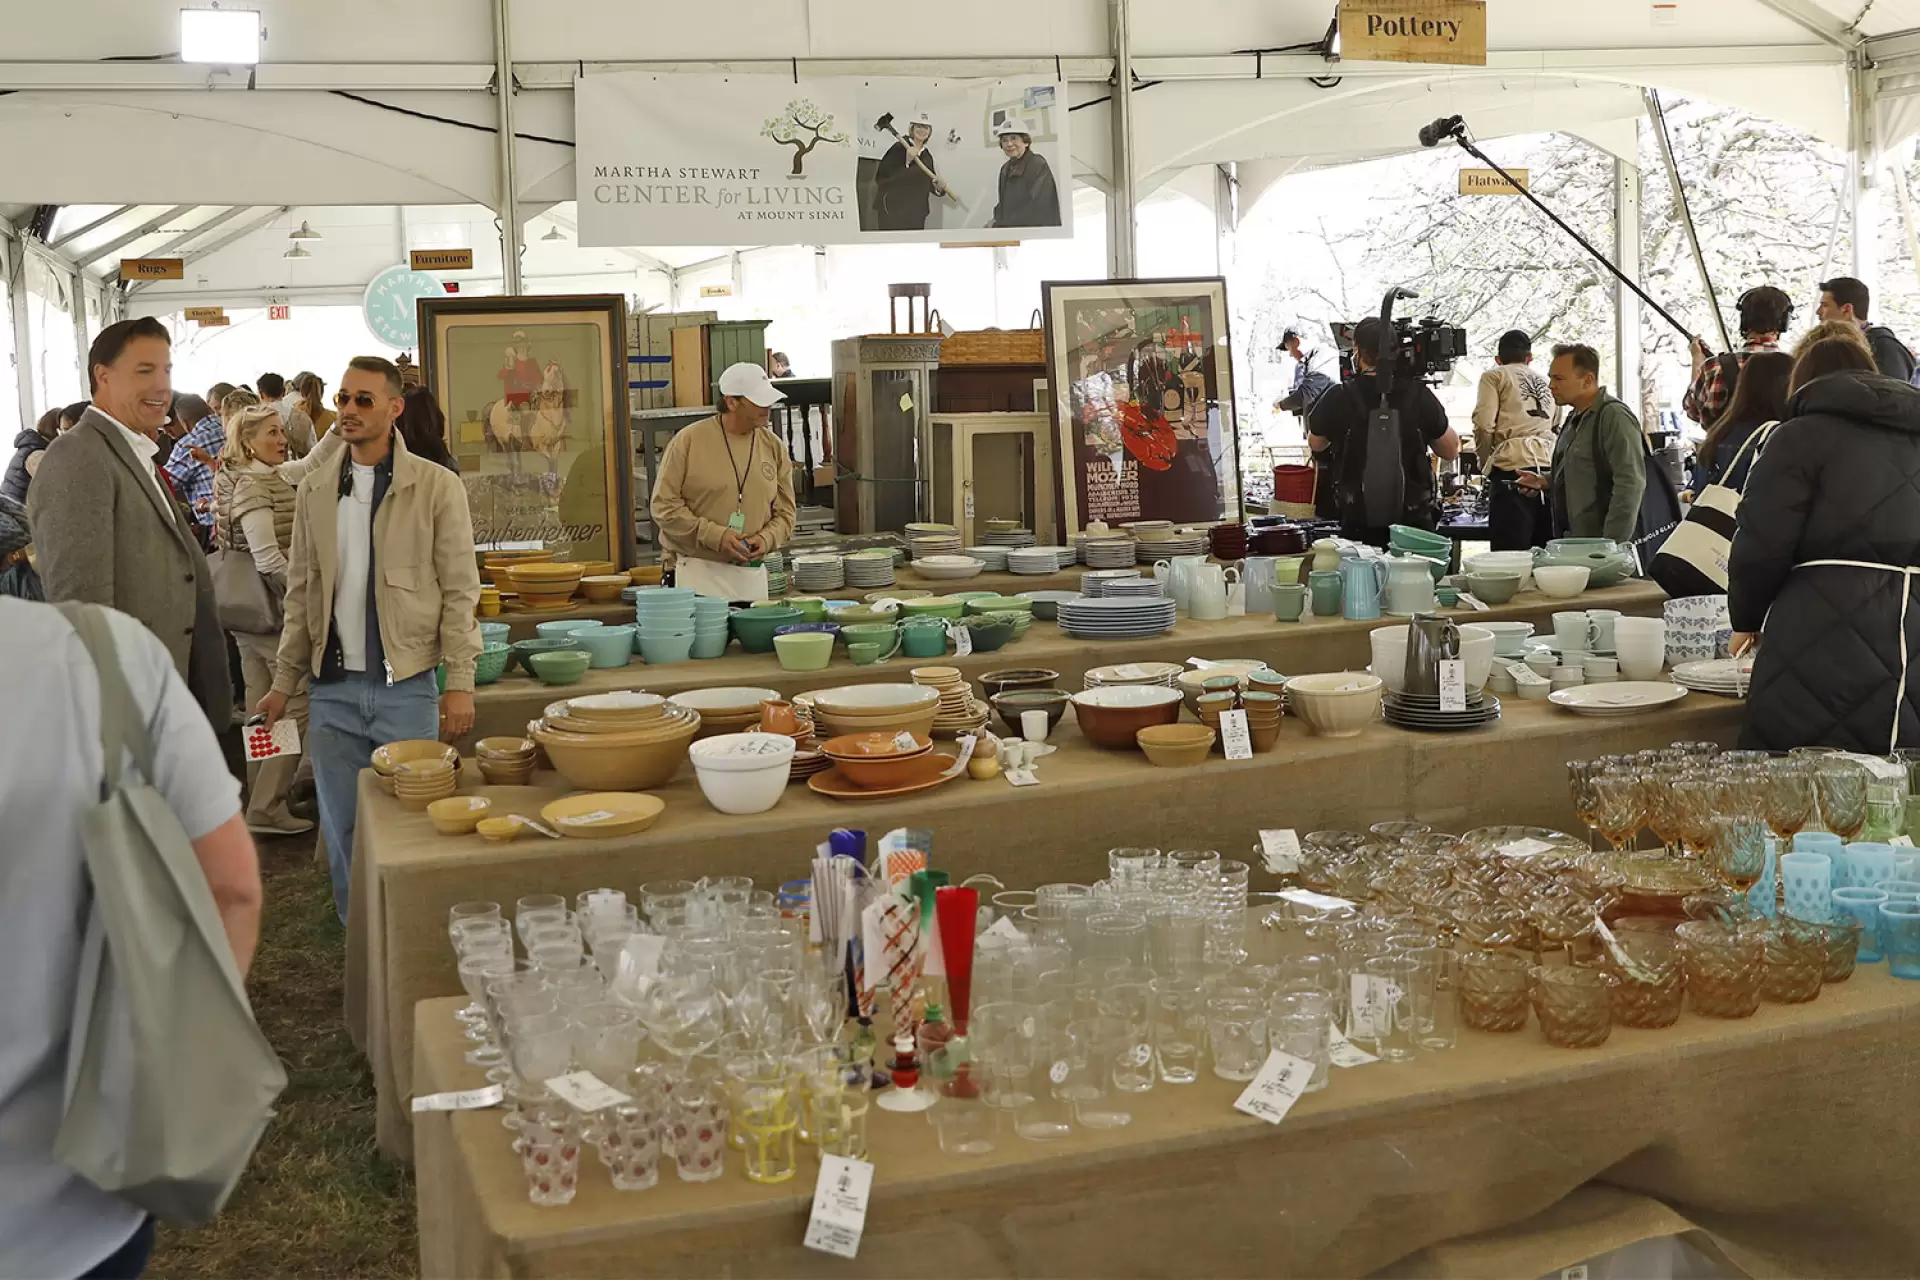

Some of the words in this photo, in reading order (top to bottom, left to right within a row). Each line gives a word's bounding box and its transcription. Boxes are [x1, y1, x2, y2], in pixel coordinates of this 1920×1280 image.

[1367, 14, 1463, 42] Pottery
[593, 166, 672, 179] MARTHA
[679, 167, 761, 180] STEWART
[1467, 174, 1522, 187] Flatwae
[593, 184, 712, 205] CENTER
[715, 187, 742, 209] for
[746, 186, 845, 206] LIVING
[737, 210, 752, 221] AT
[757, 211, 804, 221] MOUNT
[808, 211, 845, 221] SINAI
[415, 254, 468, 265] Furniture
[137, 263, 168, 275] Rugs
[376, 274, 433, 297] MARTHA
[269, 305, 290, 321] EXIT
[374, 315, 412, 341] STEW
[1086, 461, 1138, 472] WILHLM
